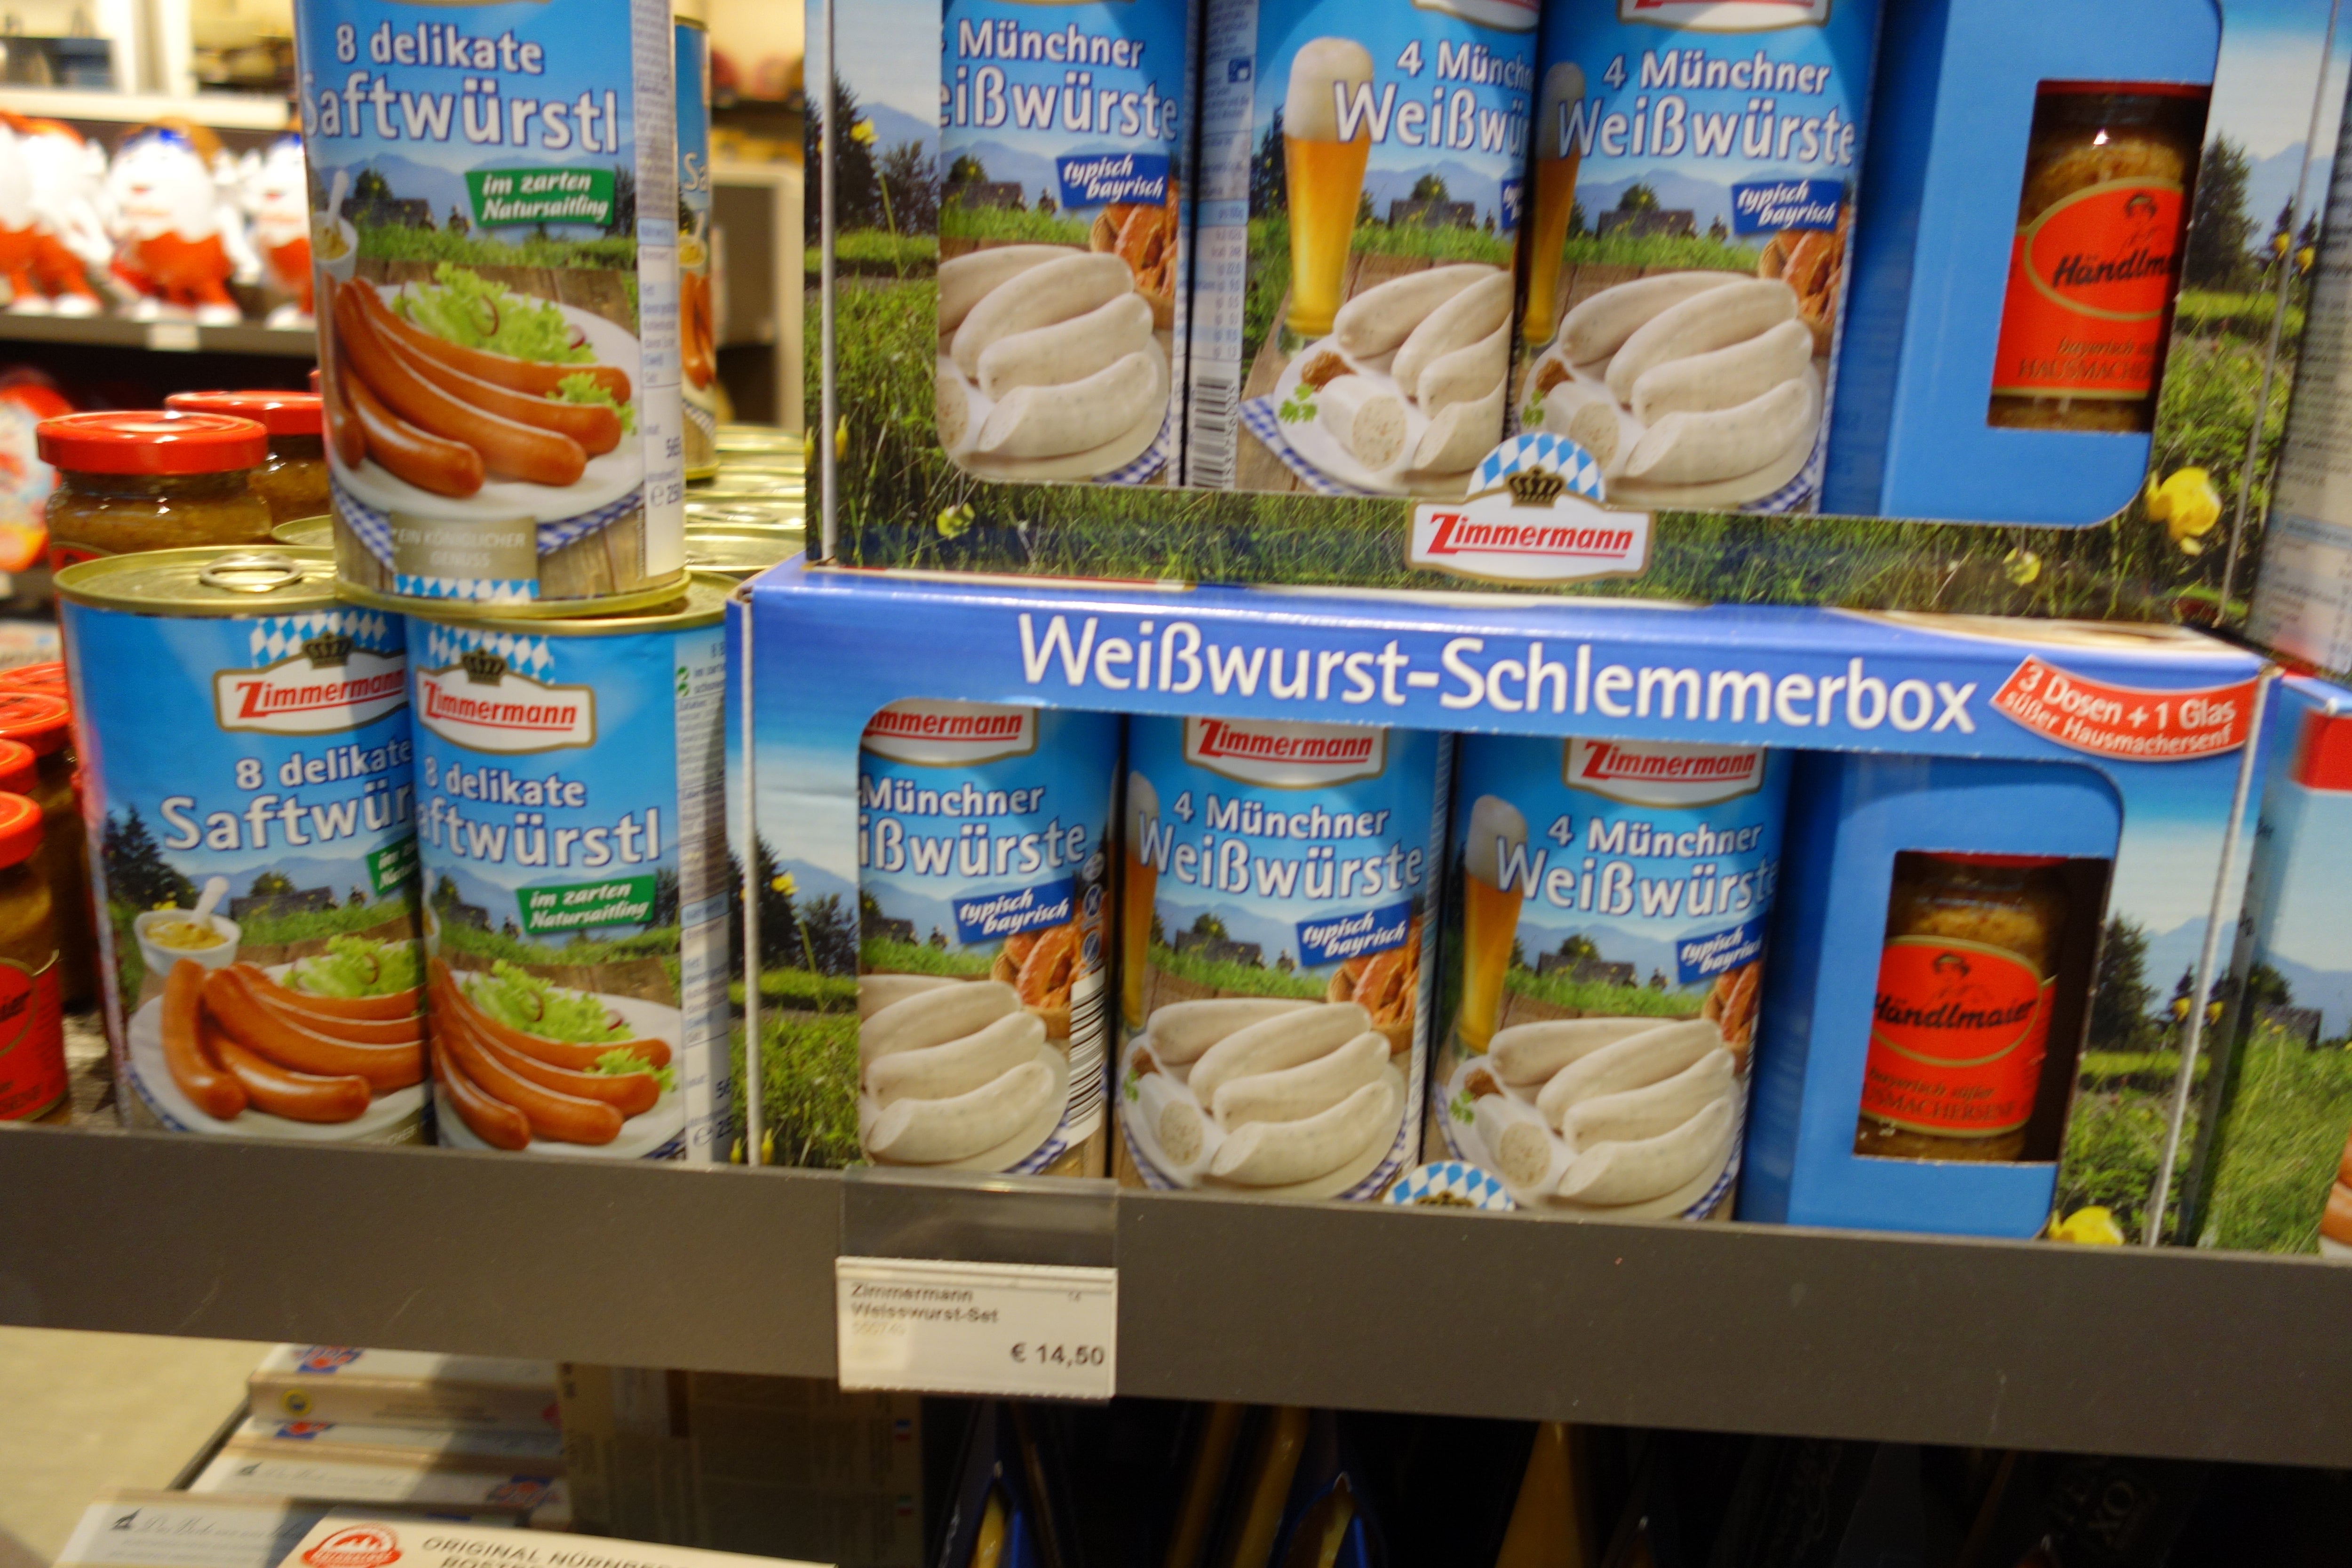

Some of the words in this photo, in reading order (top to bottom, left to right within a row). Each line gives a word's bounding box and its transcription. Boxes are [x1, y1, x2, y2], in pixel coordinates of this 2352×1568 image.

[335, 23, 356, 64] 8
[370, 20, 545, 74] delikate
[958, 18, 1144, 69] Münchner
[1396, 40, 1424, 78] 4
[1603, 54, 1627, 89] 4
[1640, 48, 1831, 95] Münchner
[1558, 95, 1855, 167] Weißwürste
[482, 174, 512, 196] im
[520, 170, 592, 195] zarten
[1063, 153, 1134, 187] typisch
[1086, 176, 1165, 204] bayrisch
[481, 194, 610, 223] Natursaitling
[1736, 180, 1810, 215] typisch
[1757, 201, 1837, 229] bayrisch
[1426, 511, 1634, 559] Zimmermann
[235, 668, 405, 719] Zimmermann
[1017, 613, 1978, 734] Weißwurst-Schlemmerbox
[422, 680, 578, 730] Zimmermann
[2019, 663, 2044, 692] 3
[2043, 673, 2123, 725] Dosen
[2129, 709, 2150, 729] +
[2154, 702, 2168, 730] 1
[2179, 697, 2237, 730] Glas
[1198, 717, 1374, 764] Zimmermann
[2061, 716, 2233, 755] Hausmachersenf
[236, 757, 263, 791] 8
[279, 737, 412, 788] delikate
[1581, 739, 1756, 783] Zimmermann
[445, 761, 587, 808] delikate
[860, 774, 1045, 818] Münchner
[1174, 790, 1194, 822] 4
[1206, 794, 1389, 840] Münchner
[1138, 812, 1424, 899] Weißwürste
[1548, 814, 1573, 847] 4
[1588, 817, 1763, 859] Münchner
[529, 900, 650, 931] Natursaitling
[530, 891, 556, 909] im
[563, 883, 632, 905] zarten
[960, 887, 1033, 927] typisch
[982, 898, 1070, 936] bayrisch
[1302, 910, 1375, 950] typisch
[1324, 920, 1406, 960] bayrisch
[1680, 924, 1744, 965] typisch
[850, 1281, 973, 1303] Zimmermann
[1011, 1342, 1027, 1363] €
[1035, 1343, 1105, 1368] 14,50
[422, 1536, 539, 1563] ORIGINAL
